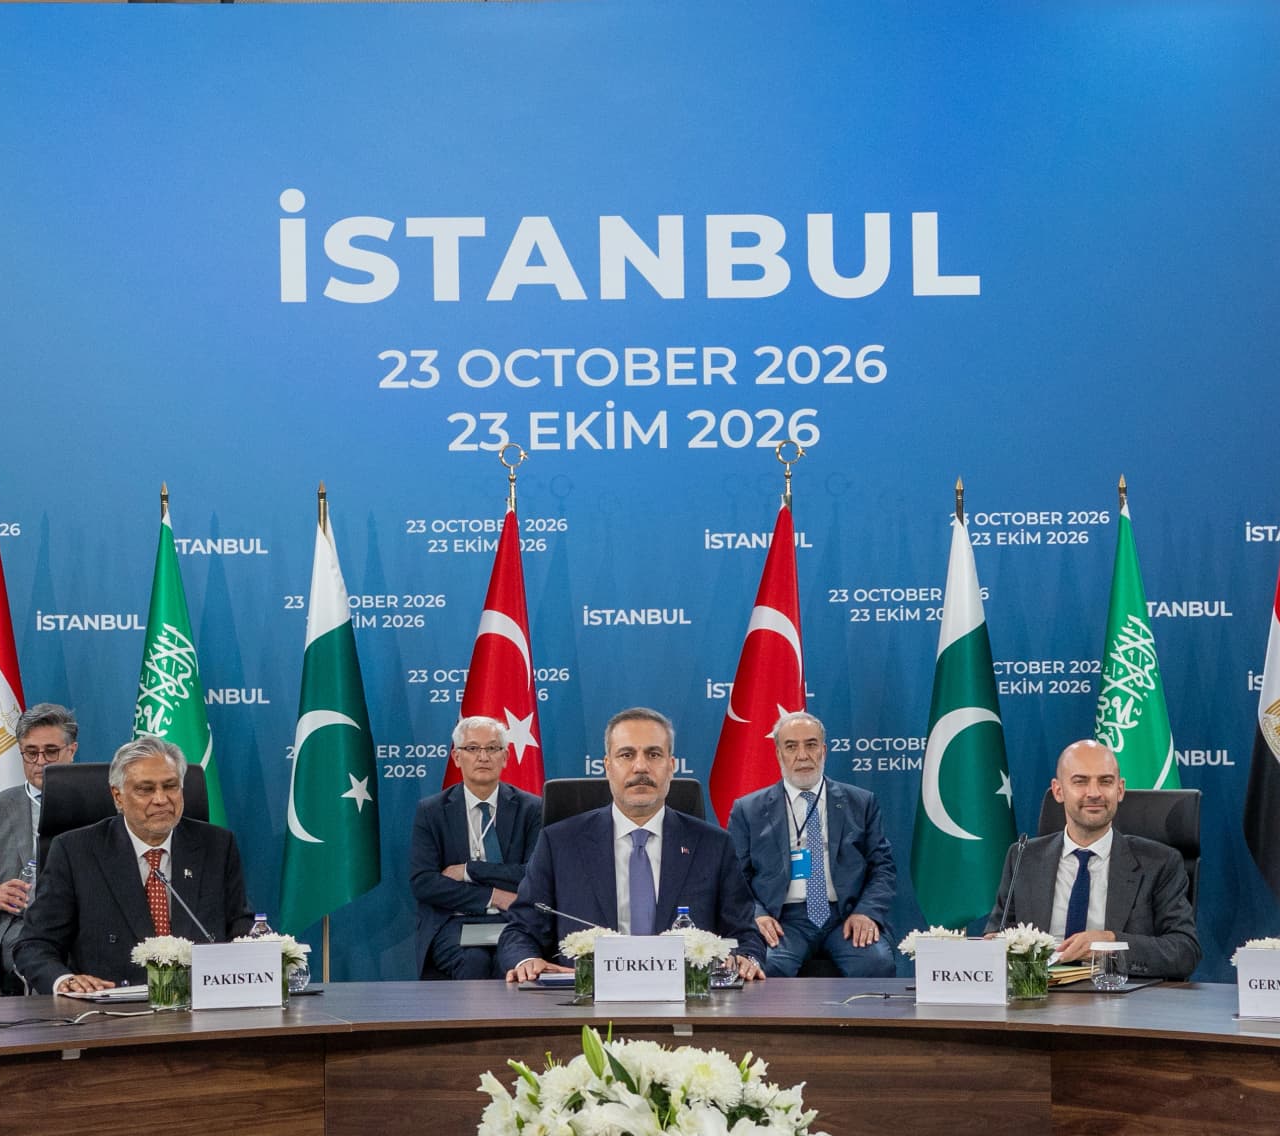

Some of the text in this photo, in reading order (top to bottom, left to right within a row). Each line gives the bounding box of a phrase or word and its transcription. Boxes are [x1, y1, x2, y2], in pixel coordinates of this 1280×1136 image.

[279, 188, 980, 304] İSTANBUL
[378, 345, 887, 388] 23 OCTOBER 2026
[448, 400, 820, 453] 23 EKİM 2026
[975, 511, 1109, 525] OCTOBER 2026
[406, 519, 567, 533] 23 2026
[428, 536, 547, 552] 23 EKİM 026
[971, 529, 1088, 546] 23 EKİM 2026
[285, 595, 445, 608] 23 OBER 2026
[829, 588, 942, 602] 23 OCTOBER
[584, 606, 691, 625] İSTANBUL
[850, 605, 920, 621] 23 EKİM
[1146, 601, 1232, 617] TANBUL
[37, 611, 145, 630] İSTANBUL
[382, 615, 424, 628] 2026
[993, 660, 1101, 674] CTOBER 202
[408, 670, 428, 682] 23
[999, 678, 1091, 694] EKİM 2026
[430, 690, 450, 702] 23
[405, 745, 447, 757] 2026
[831, 739, 850, 751] 23
[852, 755, 922, 771] 23 EKİM
[1175, 750, 1235, 766] NBUL
[384, 765, 426, 777] 2026
[603, 957, 679, 971] TÜRKİYE
[203, 972, 274, 985] PAKISTAN
[932, 971, 994, 982] FRANCE
